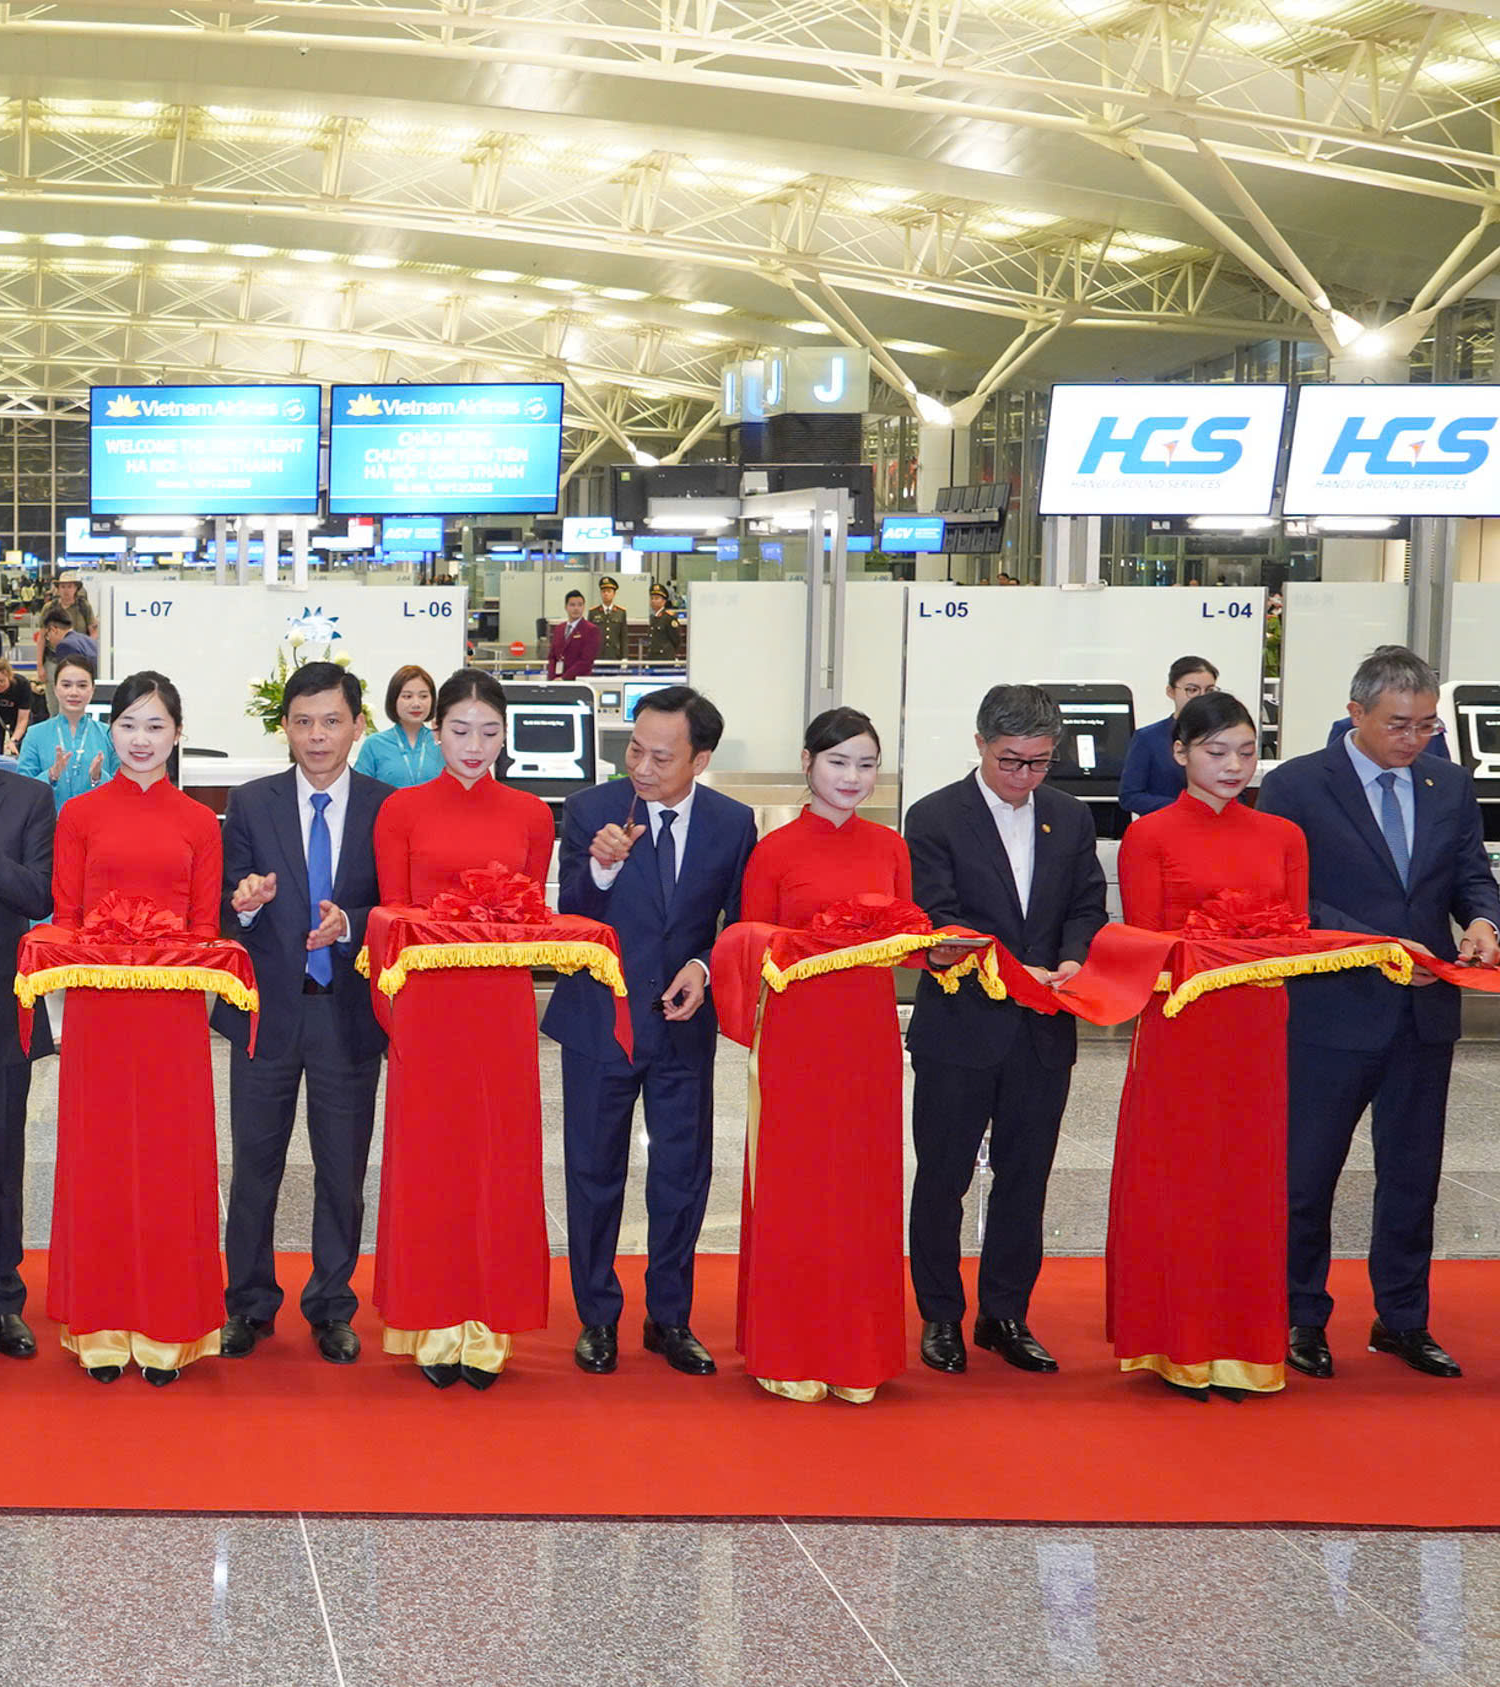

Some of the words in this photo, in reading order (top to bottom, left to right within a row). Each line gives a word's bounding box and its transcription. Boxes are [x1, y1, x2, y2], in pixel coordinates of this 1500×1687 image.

[814, 357, 844, 402] J
[141, 400, 212, 416] Vietnam
[381, 399, 455, 415] Vietnam
[1412, 480, 1468, 489] SERVICES
[125, 601, 173, 617] L-07
[403, 602, 452, 617] L-06
[920, 602, 969, 618] L-05
[1202, 602, 1253, 618] L-04
